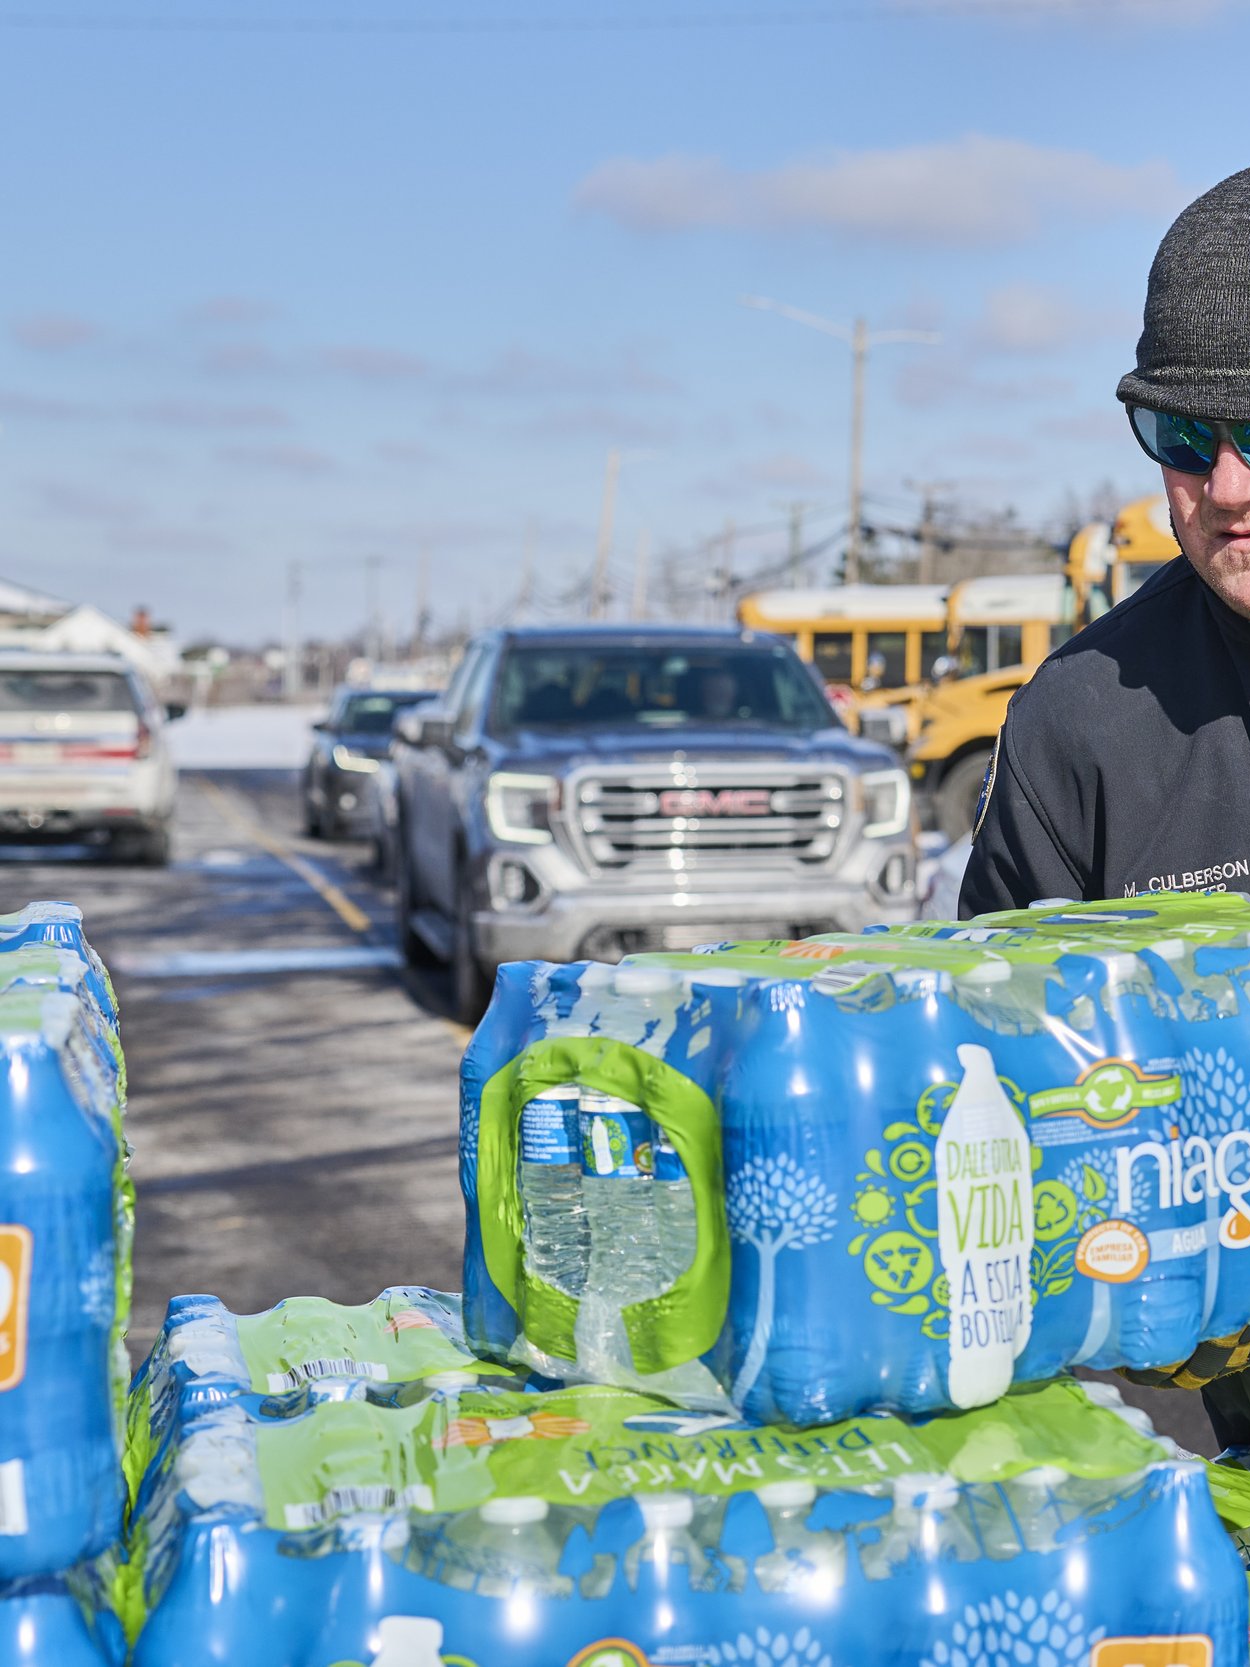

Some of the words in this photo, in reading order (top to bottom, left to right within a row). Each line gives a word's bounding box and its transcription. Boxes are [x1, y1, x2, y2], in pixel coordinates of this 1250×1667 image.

[658, 790, 772, 817] GMC
[1148, 858, 1250, 892] CULBERSON
[946, 1140, 989, 1181] DALE
[947, 1179, 1024, 1253] VIDA
[1172, 1226, 1207, 1253] AGUA
[961, 1259, 978, 1306] A
[985, 1254, 1023, 1303] ESTA
[574, 1427, 873, 1470] DIFFERENCE
[777, 1441, 914, 1477] LET'S
[559, 1469, 593, 1495] A
[612, 1457, 764, 1486] MAKE
